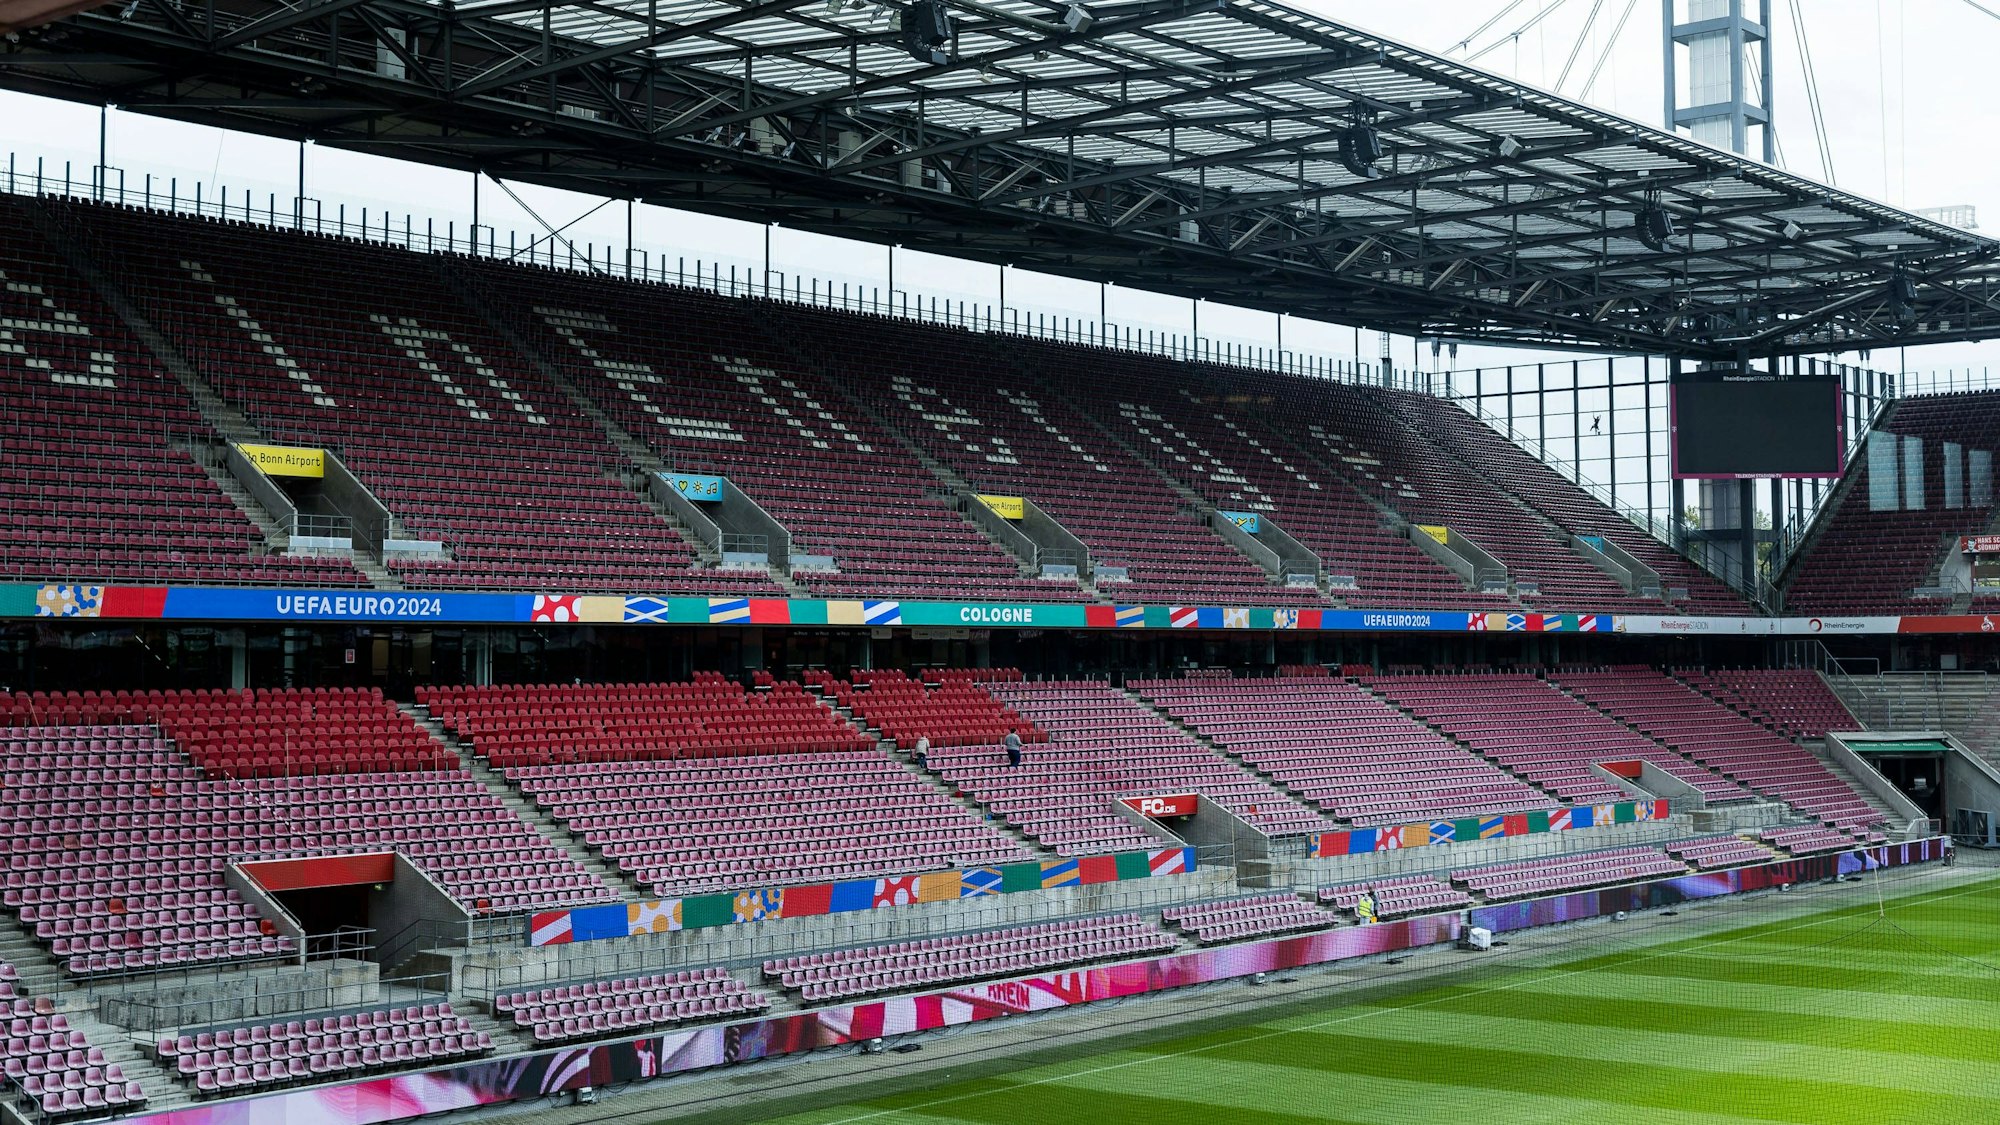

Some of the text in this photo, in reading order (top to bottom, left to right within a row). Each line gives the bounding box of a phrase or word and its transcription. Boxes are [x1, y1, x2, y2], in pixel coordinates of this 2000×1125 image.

[260, 453, 282, 464] Bonn
[285, 454, 320, 467] Airport
[960, 607, 1032, 623] COLOGNE
[1141, 798, 1176, 816] FC.DE
[987, 981, 1031, 1010] RHEIN
